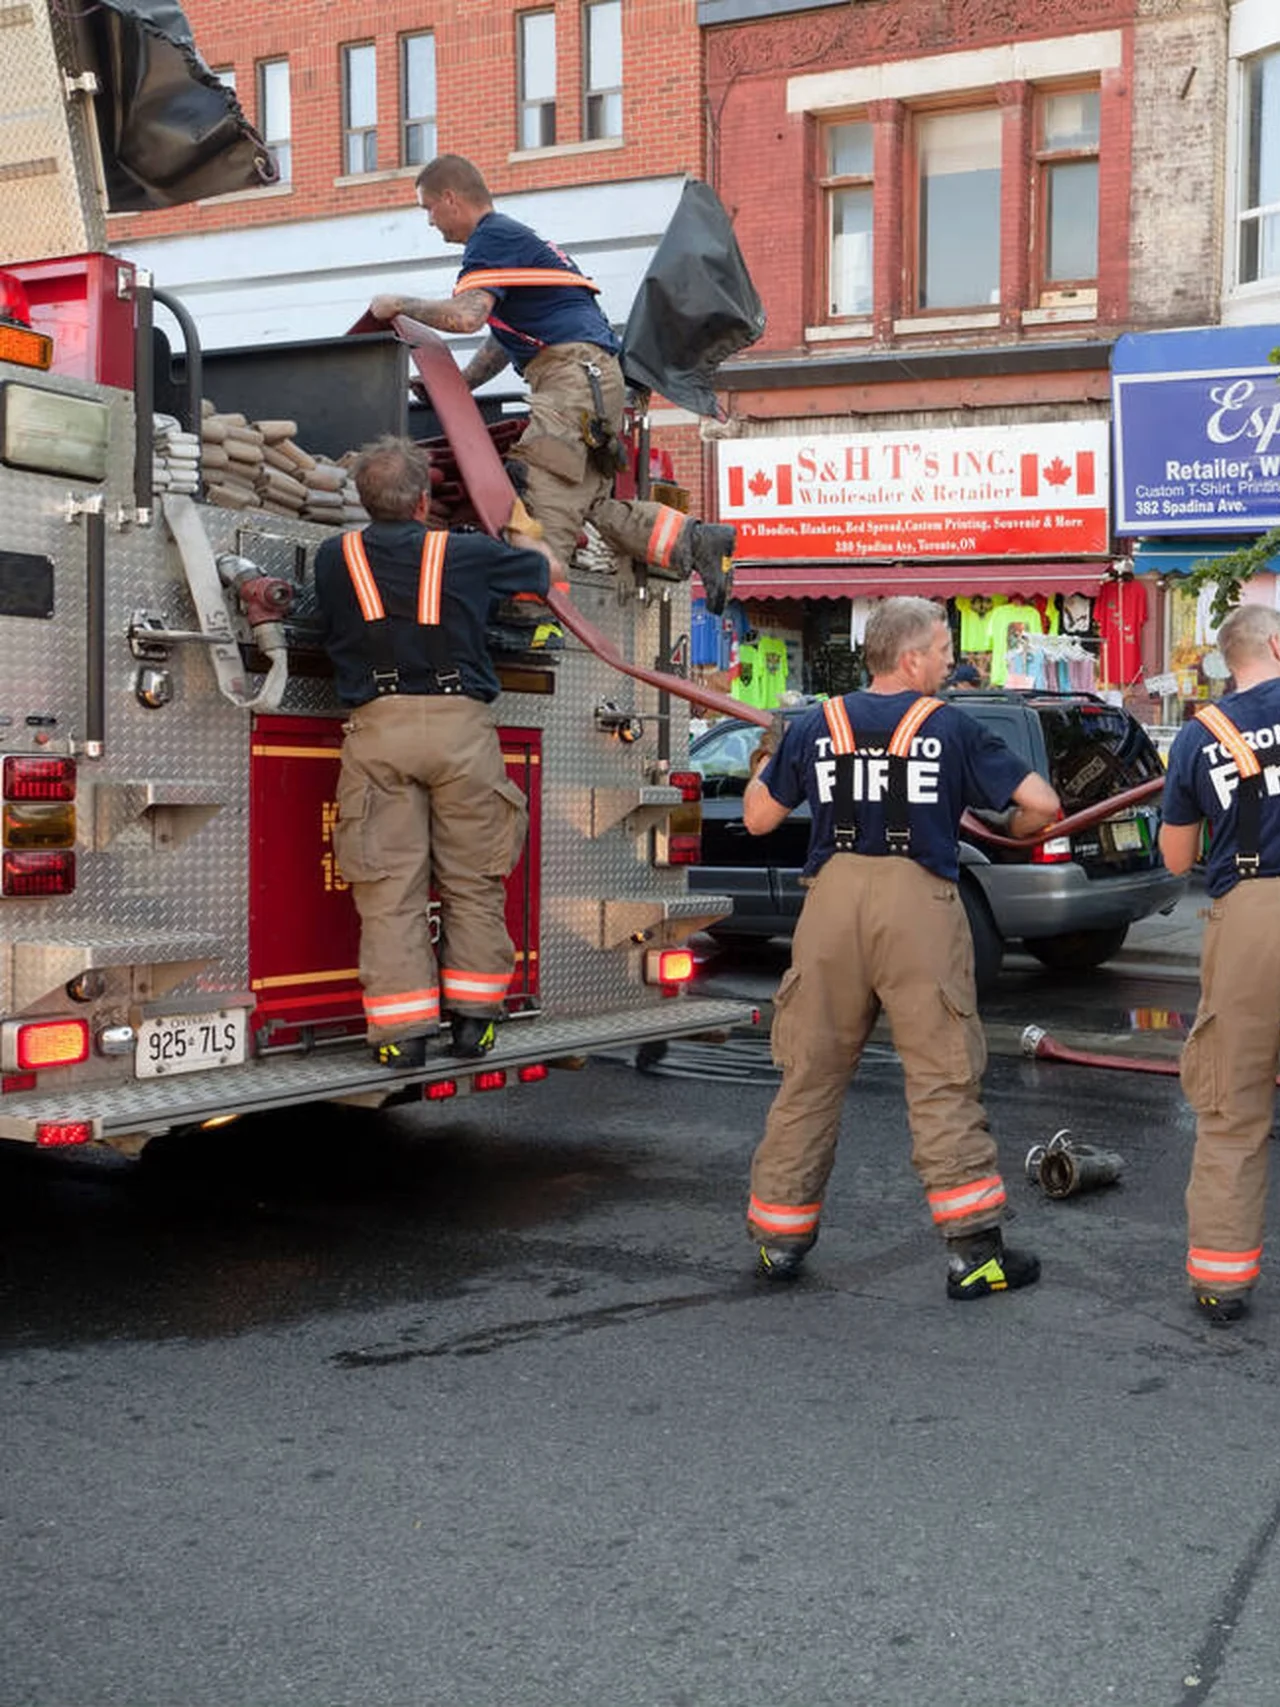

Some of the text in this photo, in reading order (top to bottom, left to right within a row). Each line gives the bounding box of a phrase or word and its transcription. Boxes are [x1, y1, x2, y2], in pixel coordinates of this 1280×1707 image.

[952, 450, 1014, 477] INC.
[1166, 459, 1253, 481] Retailer,
[799, 482, 1014, 505] Wholesaler & Retailer
[1136, 485, 1184, 498] Custom
[1136, 499, 1247, 517] 382 Spadina Ave.
[149, 1023, 236, 1060] 925 7LS
